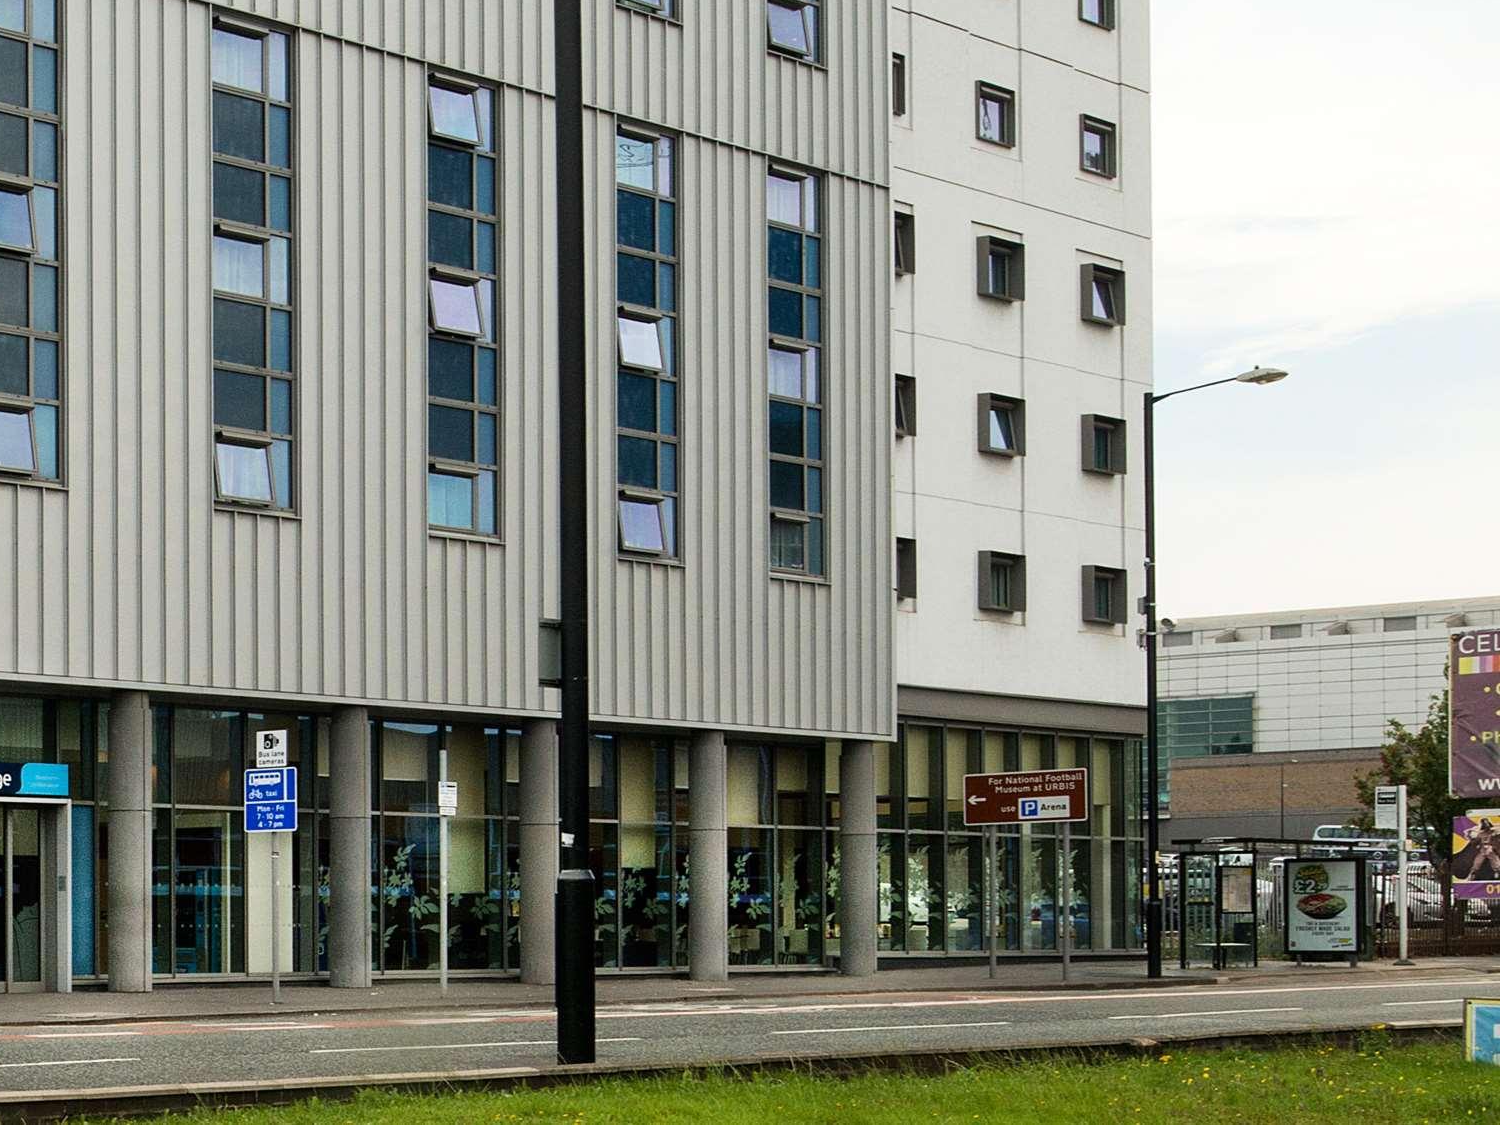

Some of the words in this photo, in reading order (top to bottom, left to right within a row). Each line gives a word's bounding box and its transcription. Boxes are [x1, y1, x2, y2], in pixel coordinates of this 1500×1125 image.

[1005, 775, 1042, 784] National
[1045, 773, 1082, 782] Football
[1033, 784, 1042, 792] at
[1045, 782, 1076, 791] URBIS
[1025, 802, 1036, 815] P
[1040, 803, 1067, 811] Arena
